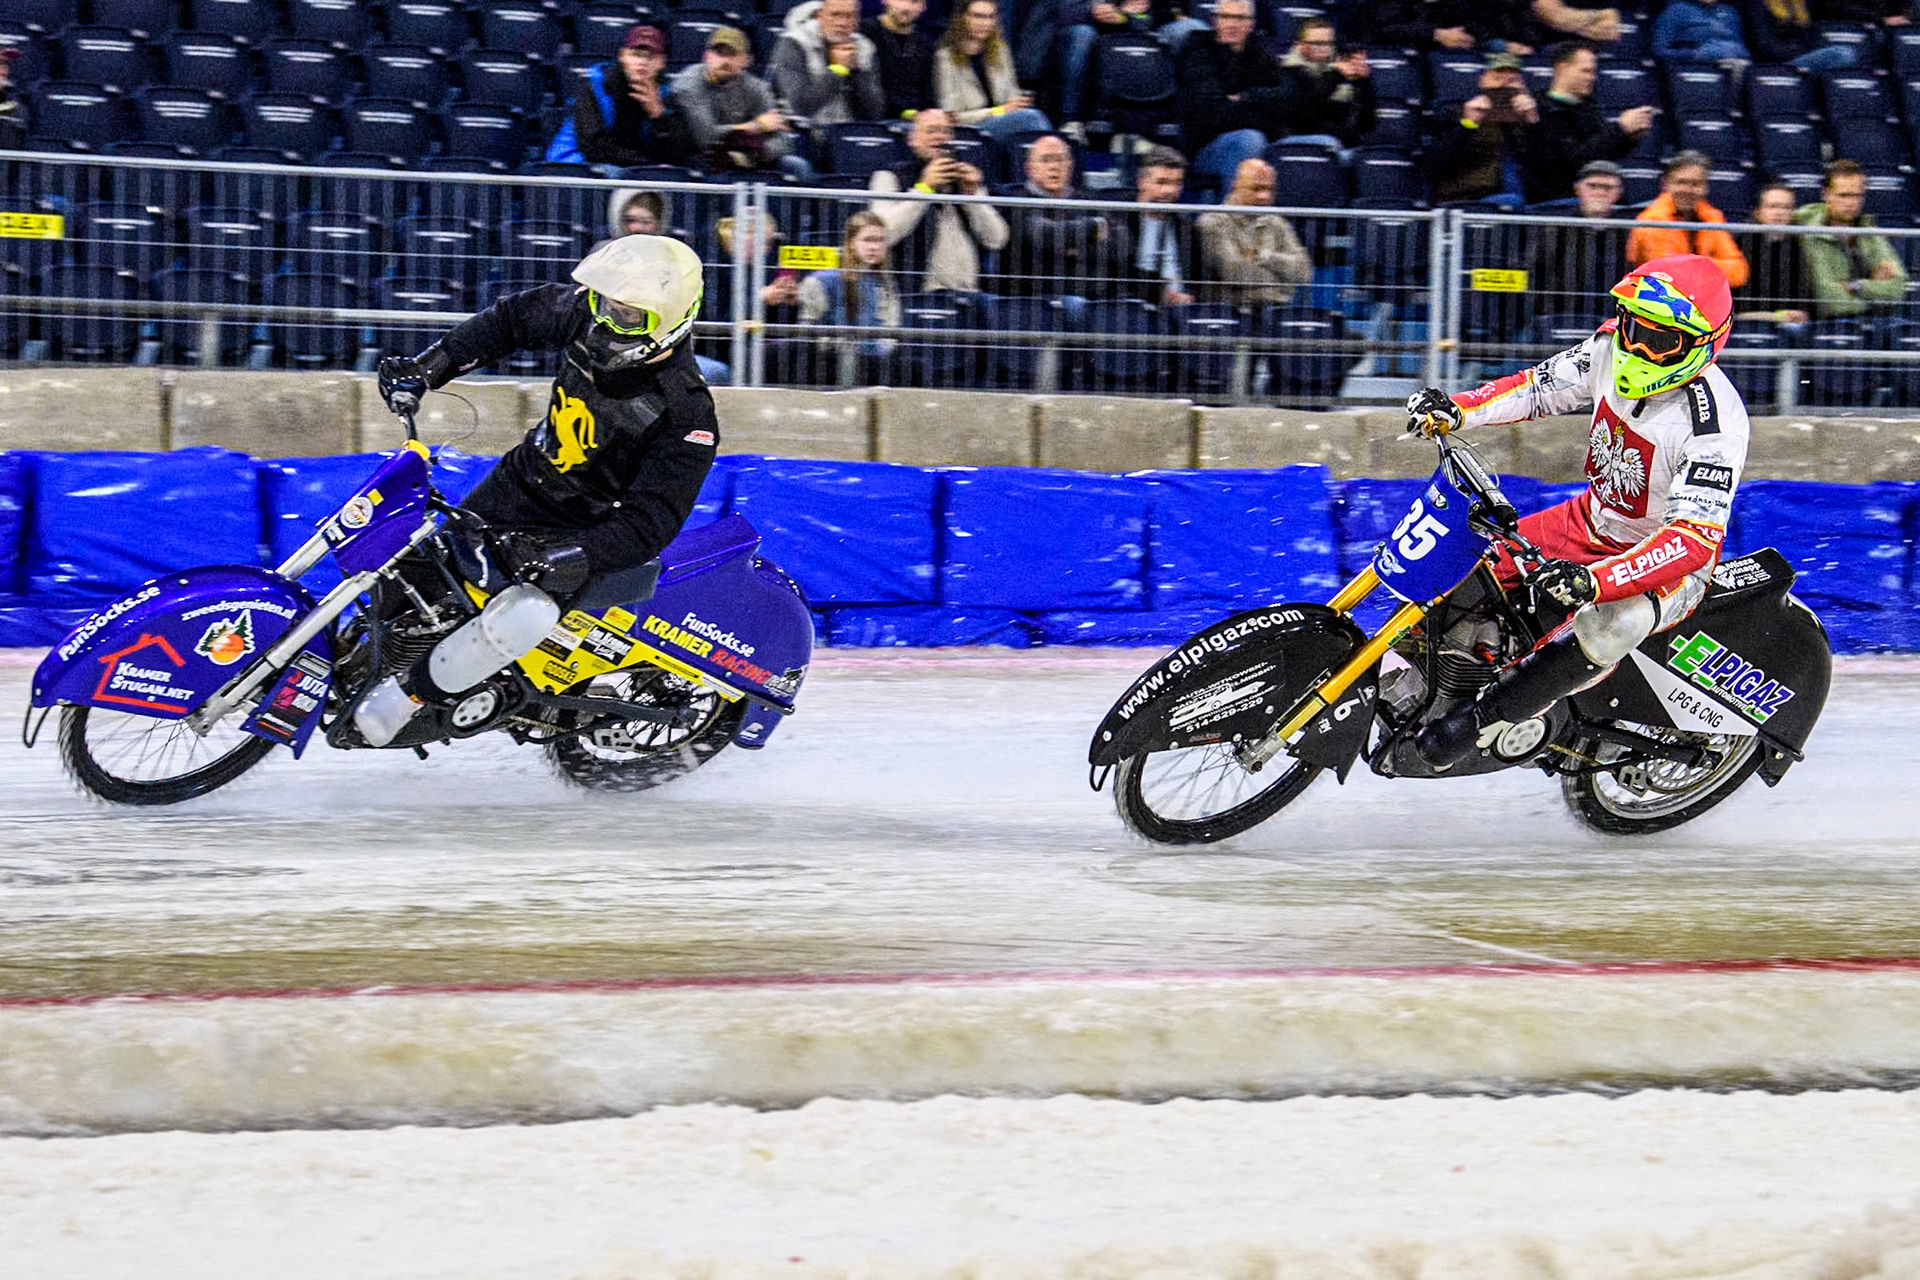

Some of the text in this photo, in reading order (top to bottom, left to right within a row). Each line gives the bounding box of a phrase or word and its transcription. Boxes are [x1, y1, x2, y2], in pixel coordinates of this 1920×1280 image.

[1689, 382, 1711, 424] joma
[1391, 498, 1450, 561] 35
[1730, 563, 1761, 575] Knapp
[642, 615, 714, 658] KRAMER
[709, 648, 772, 685] RACING
[681, 612, 755, 657] FunSocks.se
[116, 662, 172, 682] KRAMER
[1118, 606, 1305, 721] www.elpigaz.com
[1669, 631, 1795, 717] ELPIGAZ
[1667, 688, 1724, 728] LPG & CNG
[1711, 685, 1748, 712] AUTOMOTIVE
